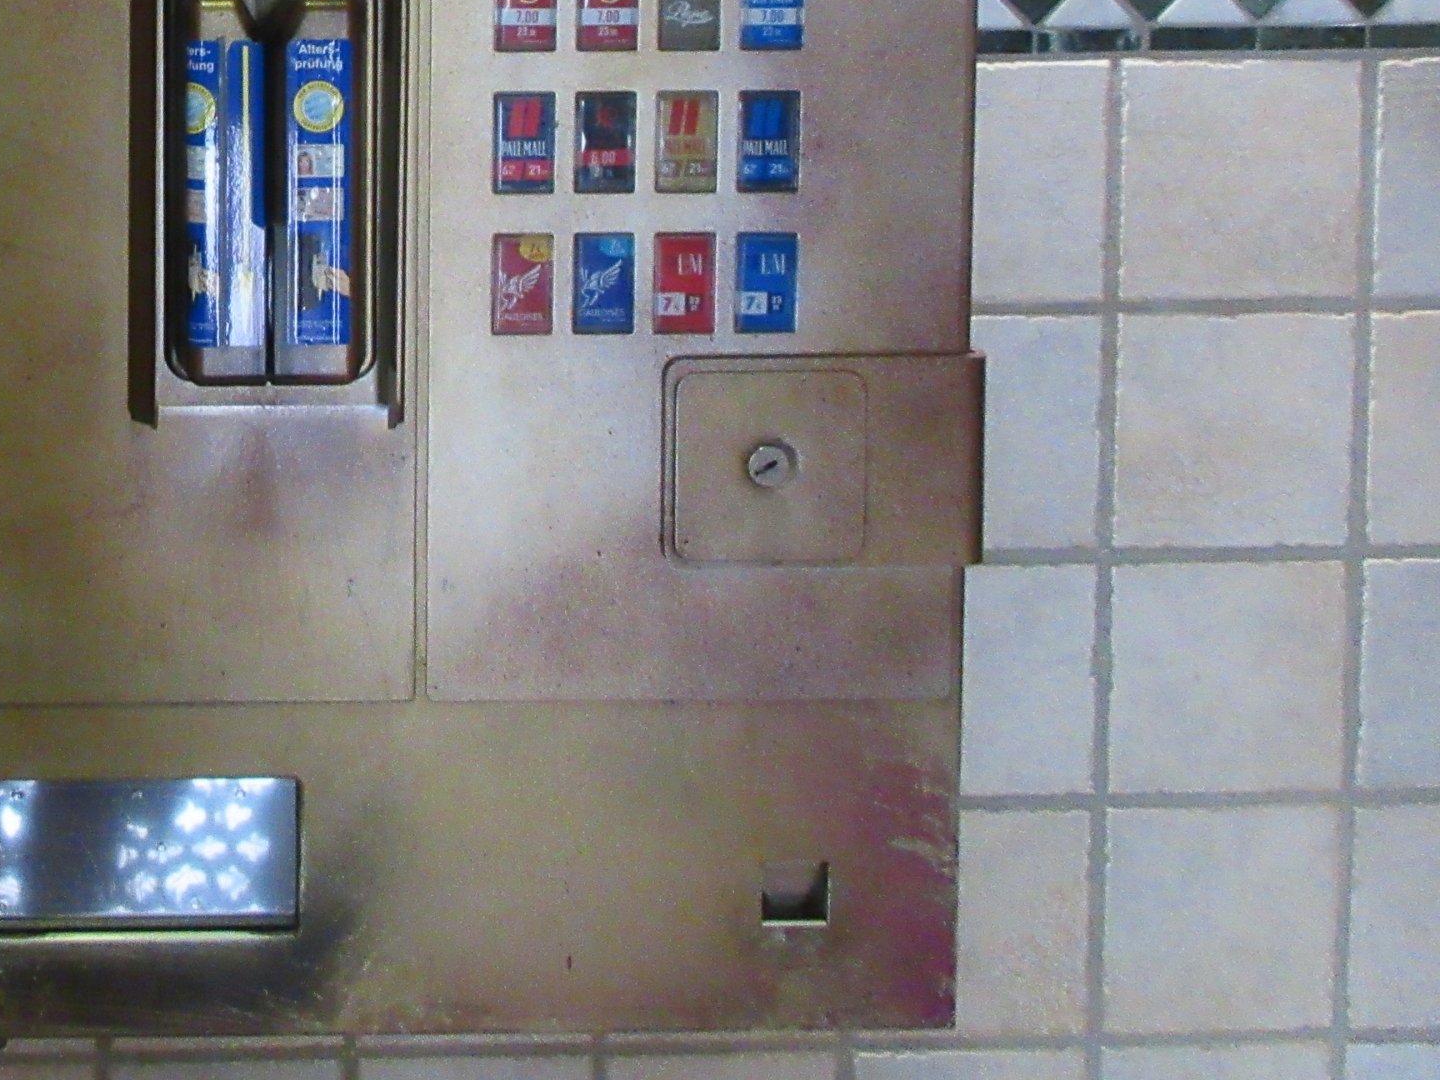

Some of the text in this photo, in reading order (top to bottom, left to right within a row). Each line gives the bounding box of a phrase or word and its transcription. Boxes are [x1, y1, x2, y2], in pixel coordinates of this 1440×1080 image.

[516, 10, 539, 23] 7.00
[597, 10, 620, 23] 7.00
[761, 9, 784, 22] 7.00
[299, 44, 340, 55] Alters-
[294, 57, 343, 72] prüfung
[502, 140, 546, 157] PALL MALL
[764, 139, 788, 155] MALL
